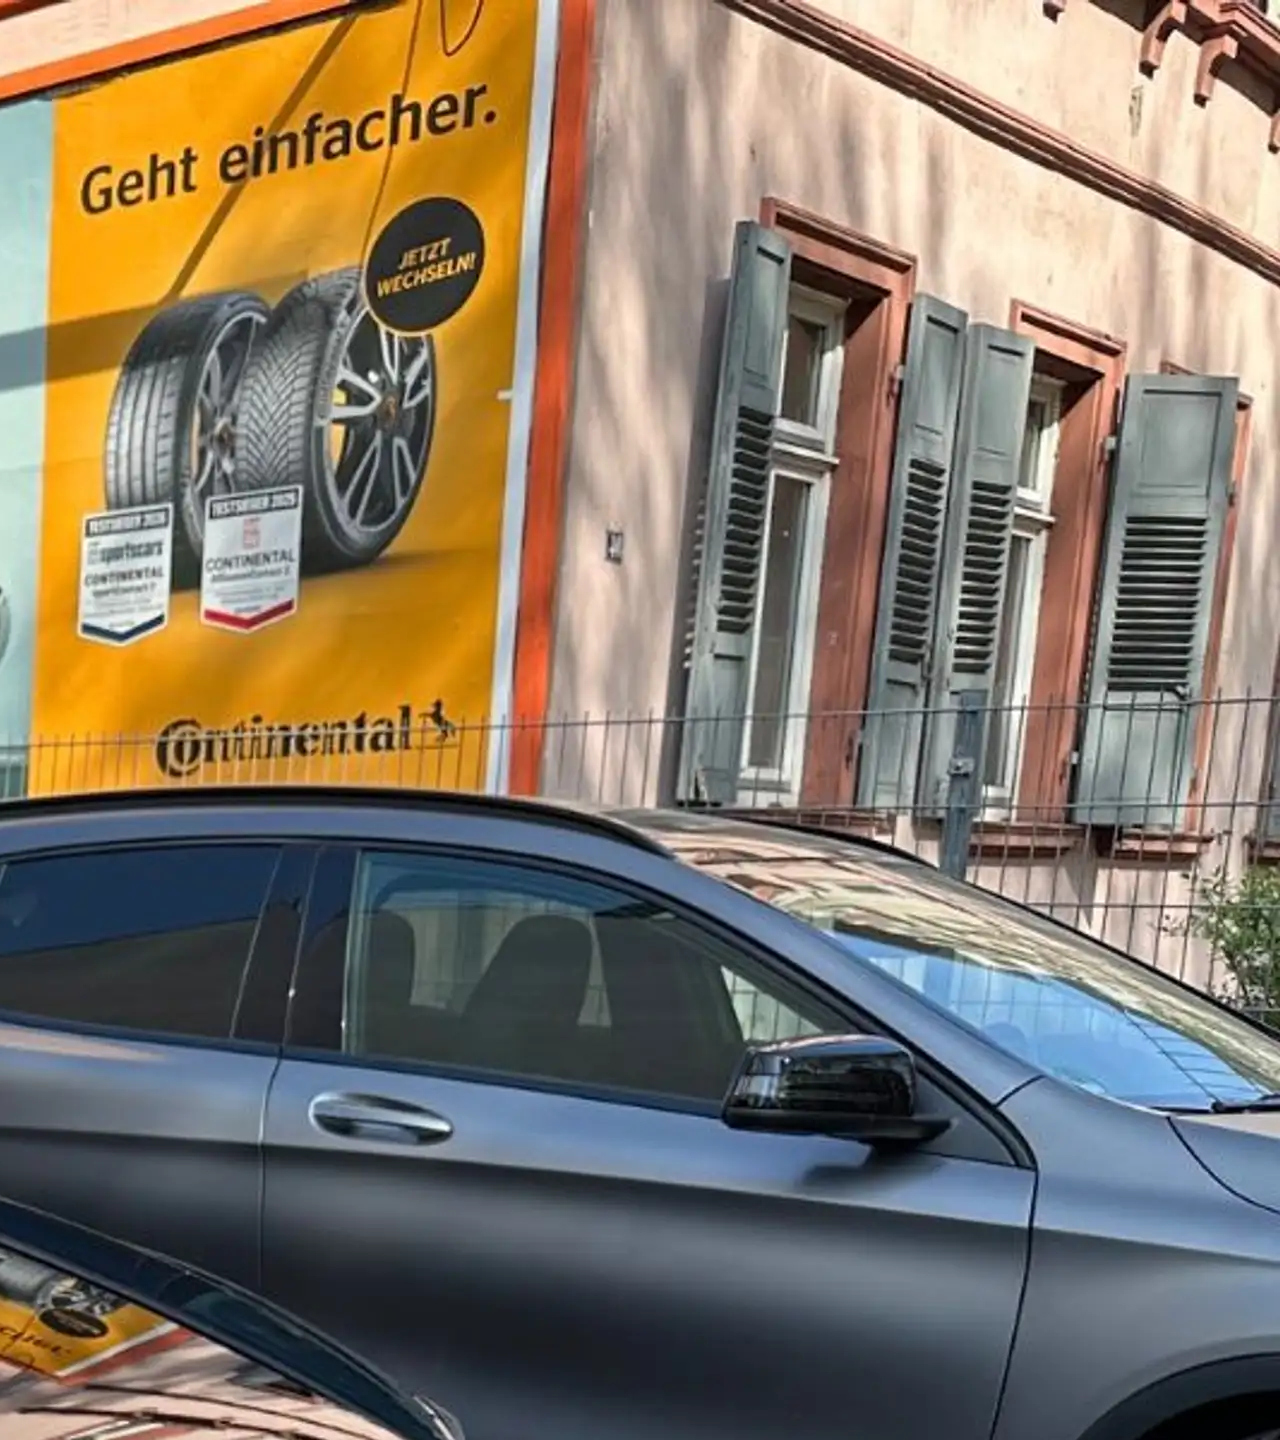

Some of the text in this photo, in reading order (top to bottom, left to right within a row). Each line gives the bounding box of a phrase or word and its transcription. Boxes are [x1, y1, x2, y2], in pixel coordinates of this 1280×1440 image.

[81, 83, 497, 215] Geht einfacher.
[377, 251, 476, 297] WECHSELN!
[398, 237, 451, 270] JETZT
[206, 547, 296, 572] CONTINENTAL
[155, 704, 412, 778] Continental
